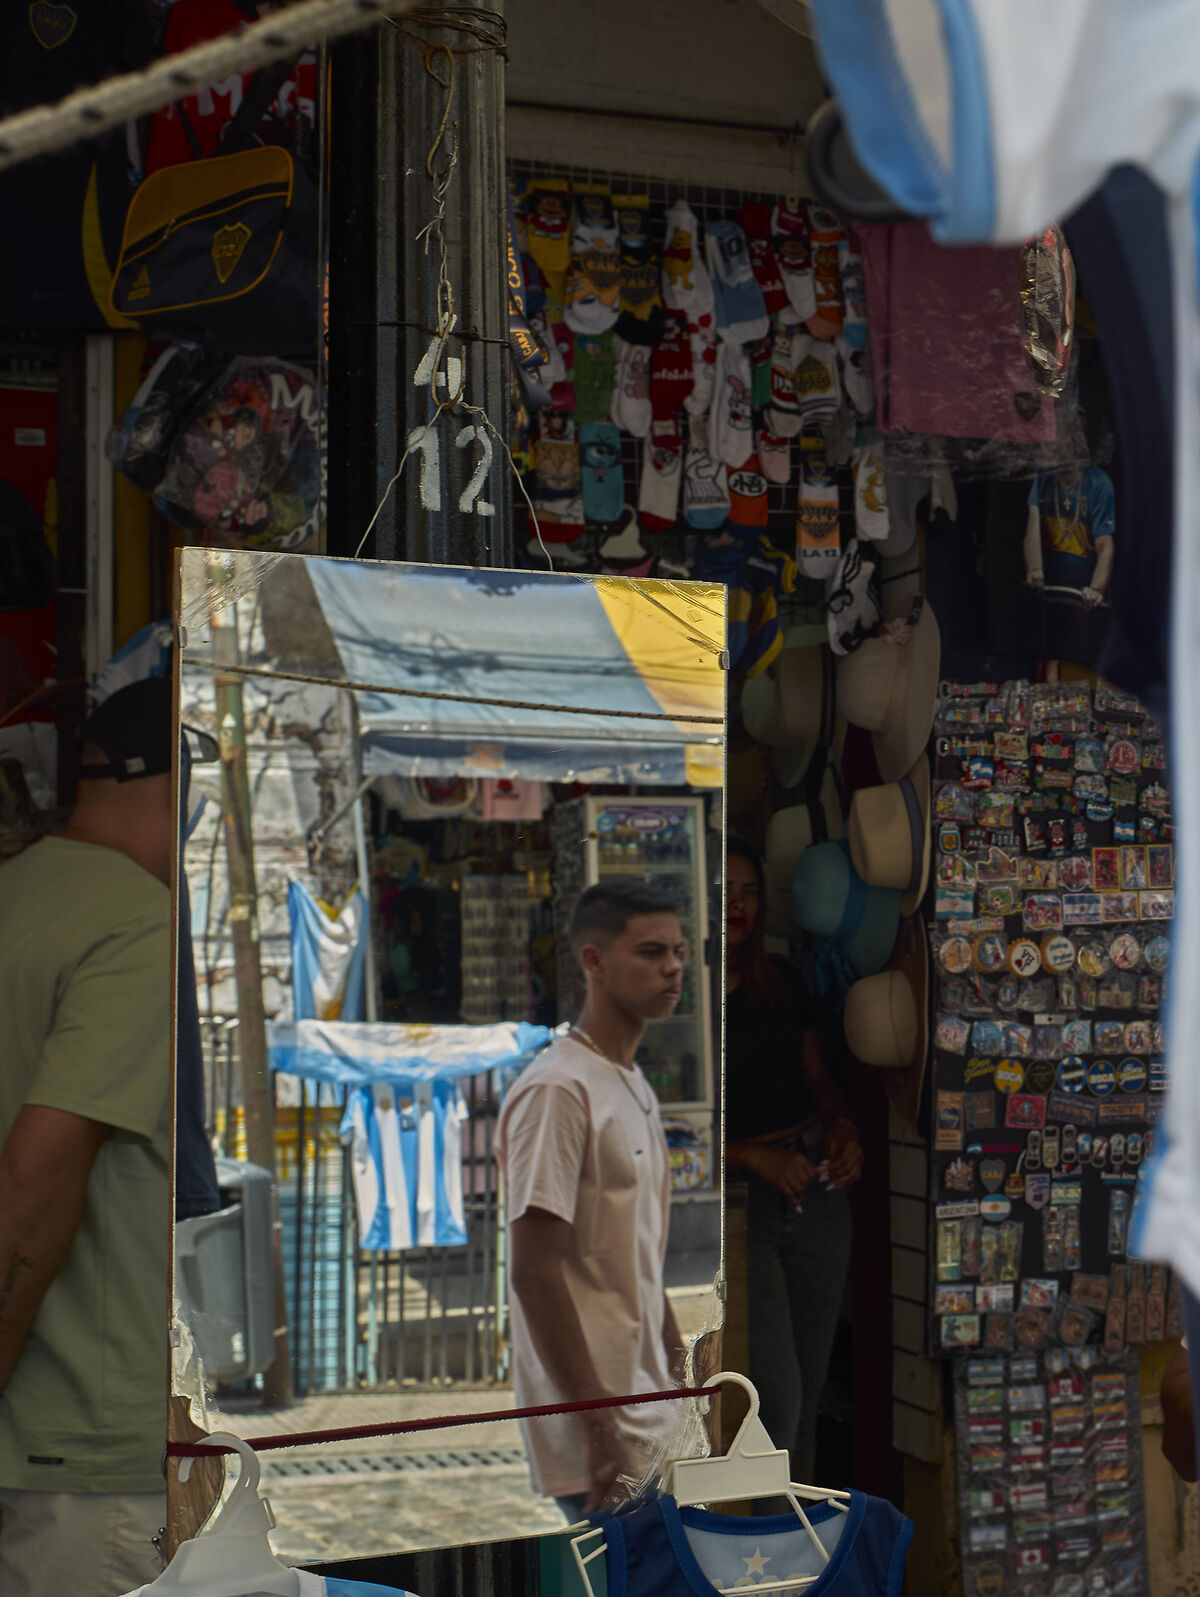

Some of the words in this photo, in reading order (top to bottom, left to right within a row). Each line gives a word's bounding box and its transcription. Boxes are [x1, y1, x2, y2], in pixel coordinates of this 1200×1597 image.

[405, 424, 496, 518] 12
[802, 549, 821, 559] LA
[823, 549, 839, 559] 12
